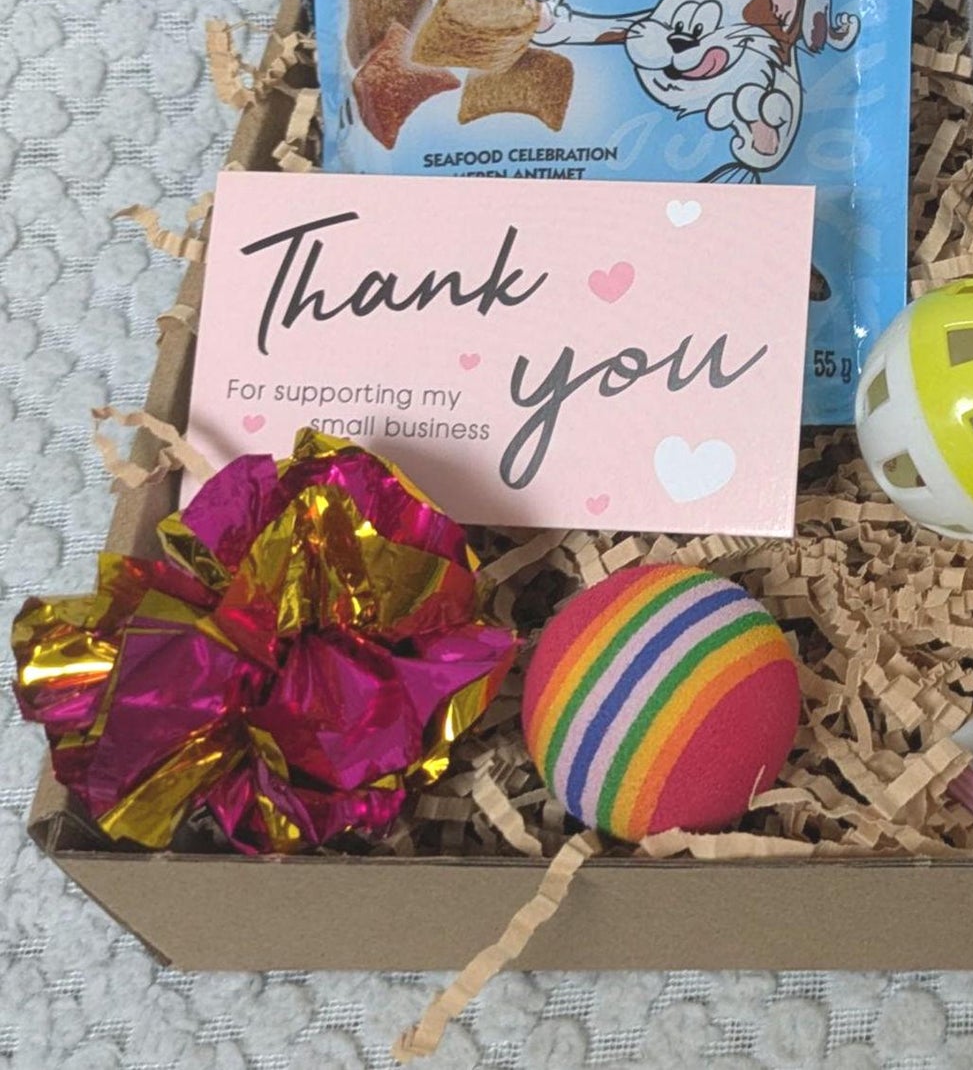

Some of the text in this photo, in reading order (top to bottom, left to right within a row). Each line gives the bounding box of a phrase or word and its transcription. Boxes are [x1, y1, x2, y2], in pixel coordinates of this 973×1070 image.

[423, 146, 619, 168] SEAFOOD CELEBRATION
[240, 210, 549, 356] Thank
[814, 349, 852, 383] 55 g
[226, 379, 462, 411] For supporting my
[308, 416, 491, 440] small business
[498, 333, 769, 491] you
